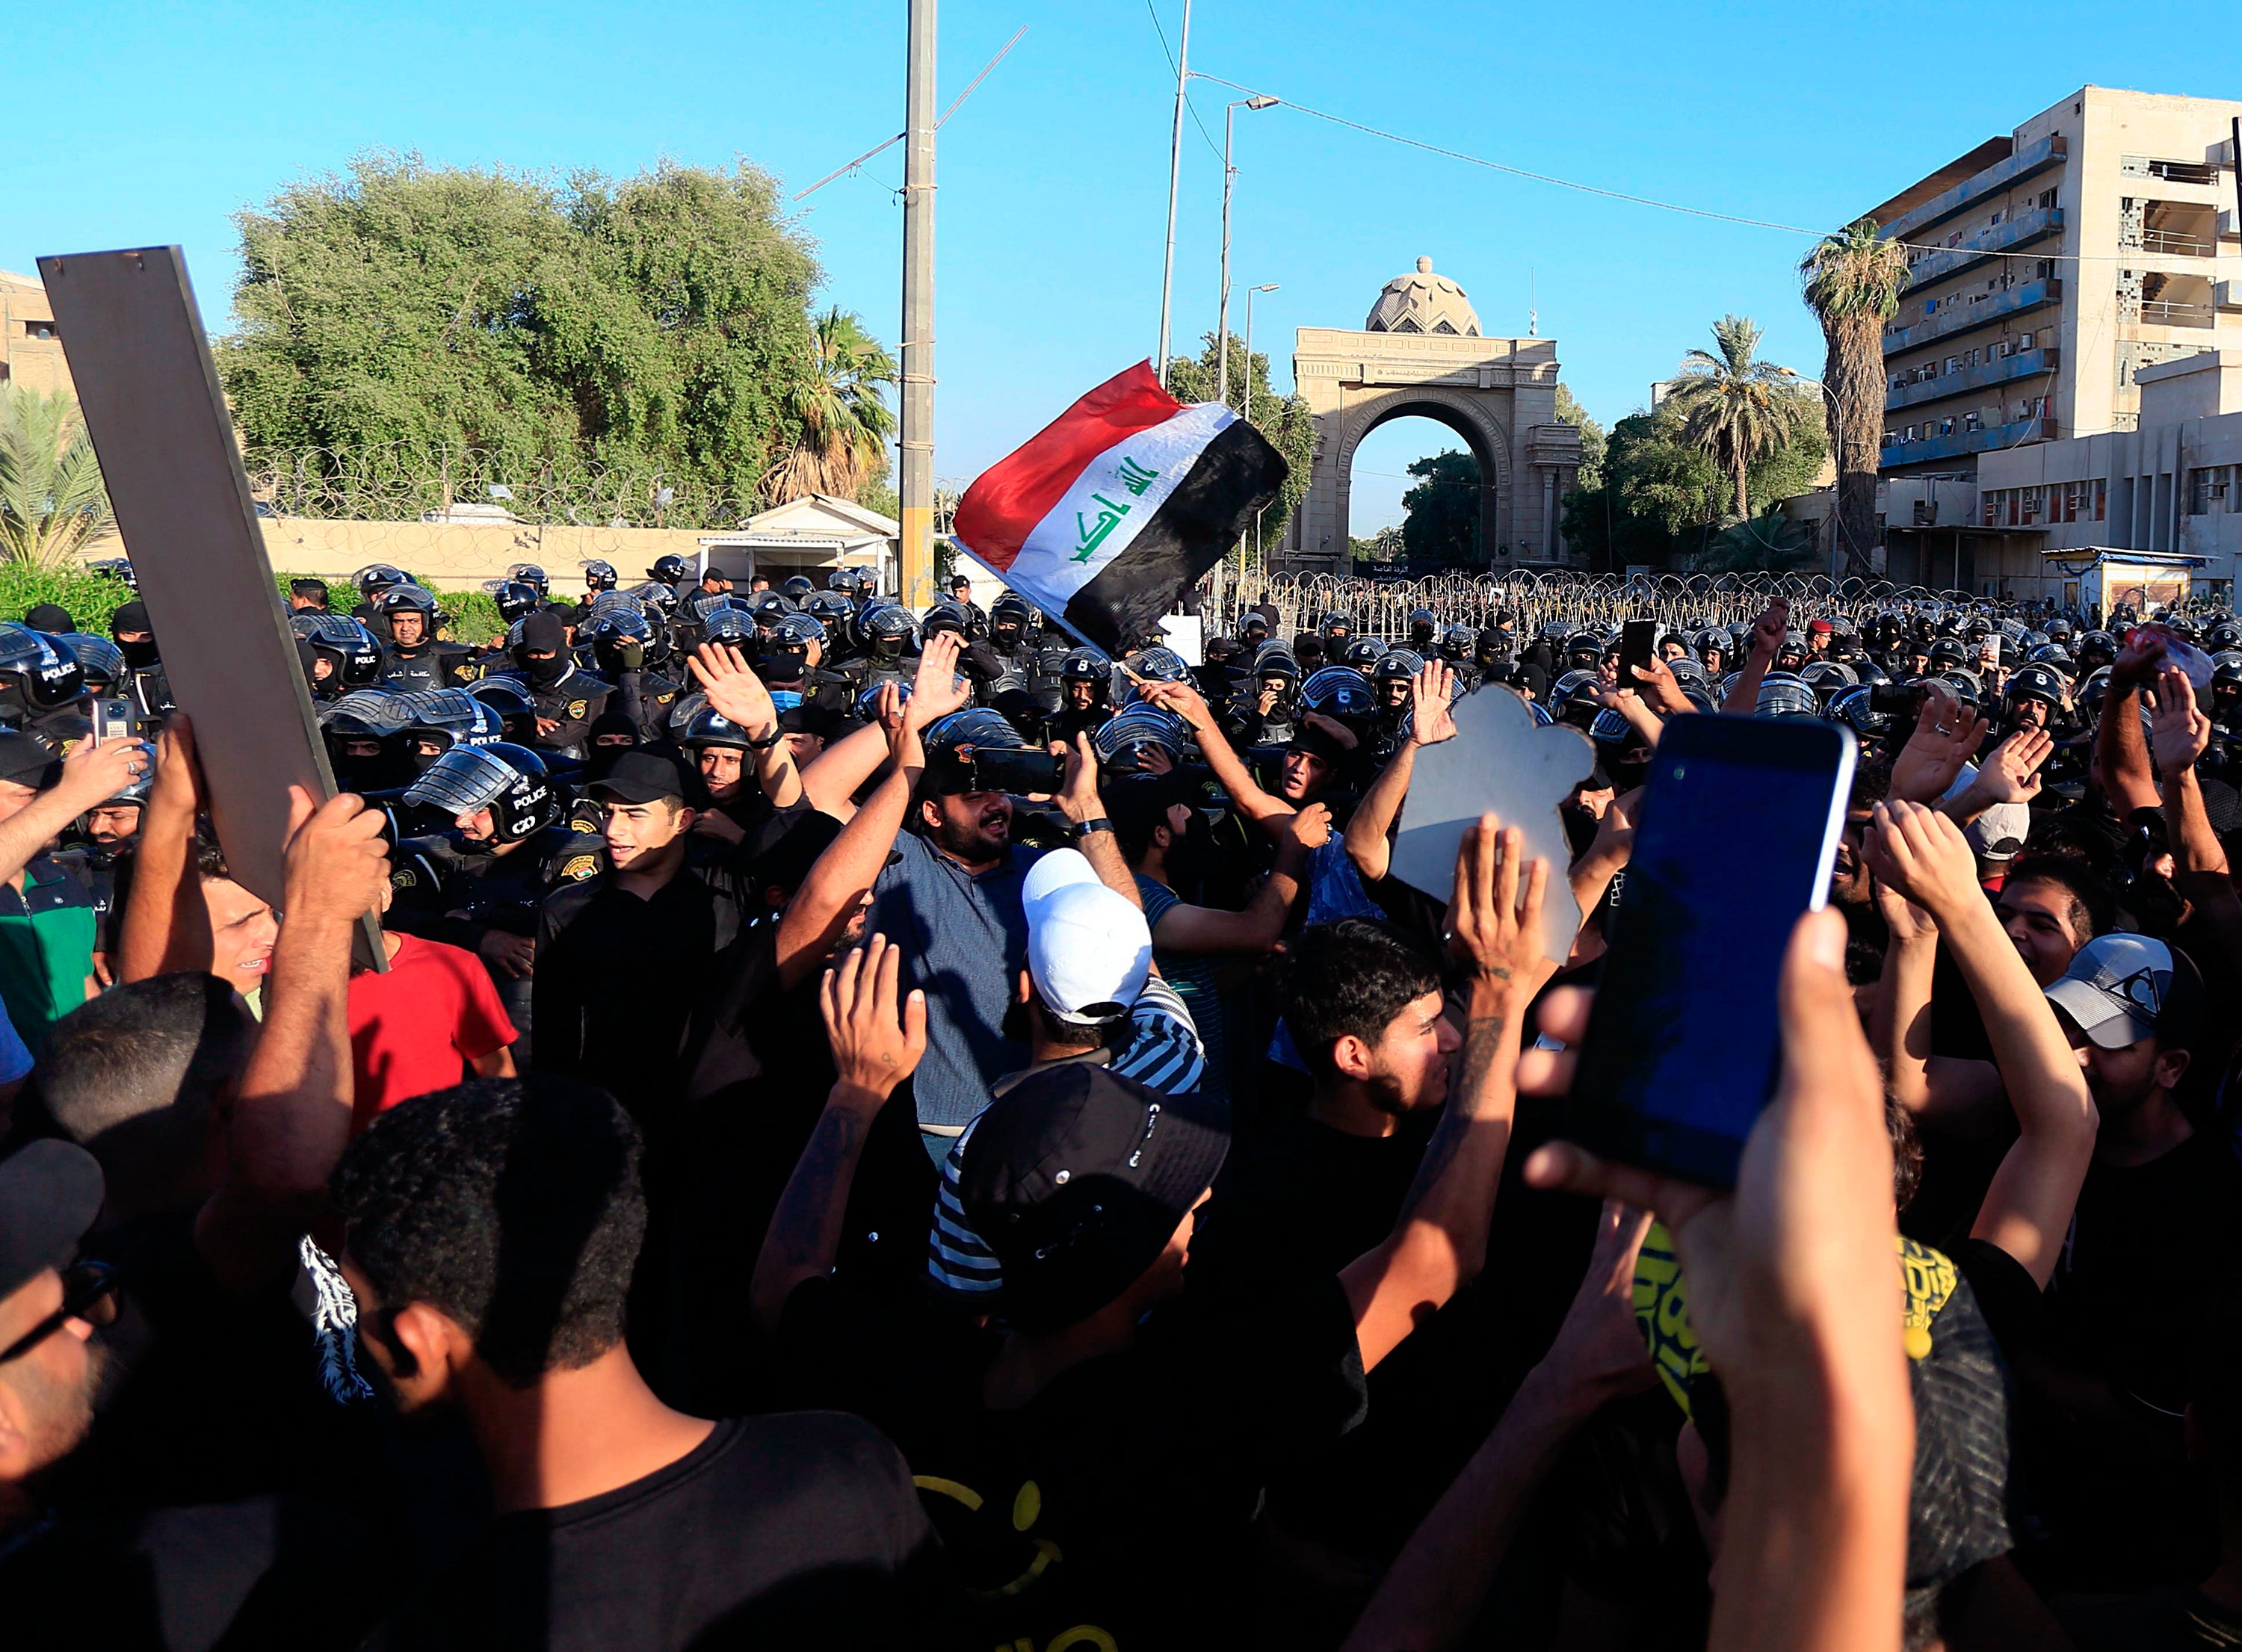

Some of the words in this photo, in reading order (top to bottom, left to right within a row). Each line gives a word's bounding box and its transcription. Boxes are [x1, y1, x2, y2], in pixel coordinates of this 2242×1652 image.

[2223, 631, 2232, 639] 6
[355, 655, 376, 665] POLIC
[1077, 659, 1089, 672] 8
[41, 661, 77, 681] POLICE
[2035, 673, 2048, 686] 8
[513, 785, 548, 811] POLICE
